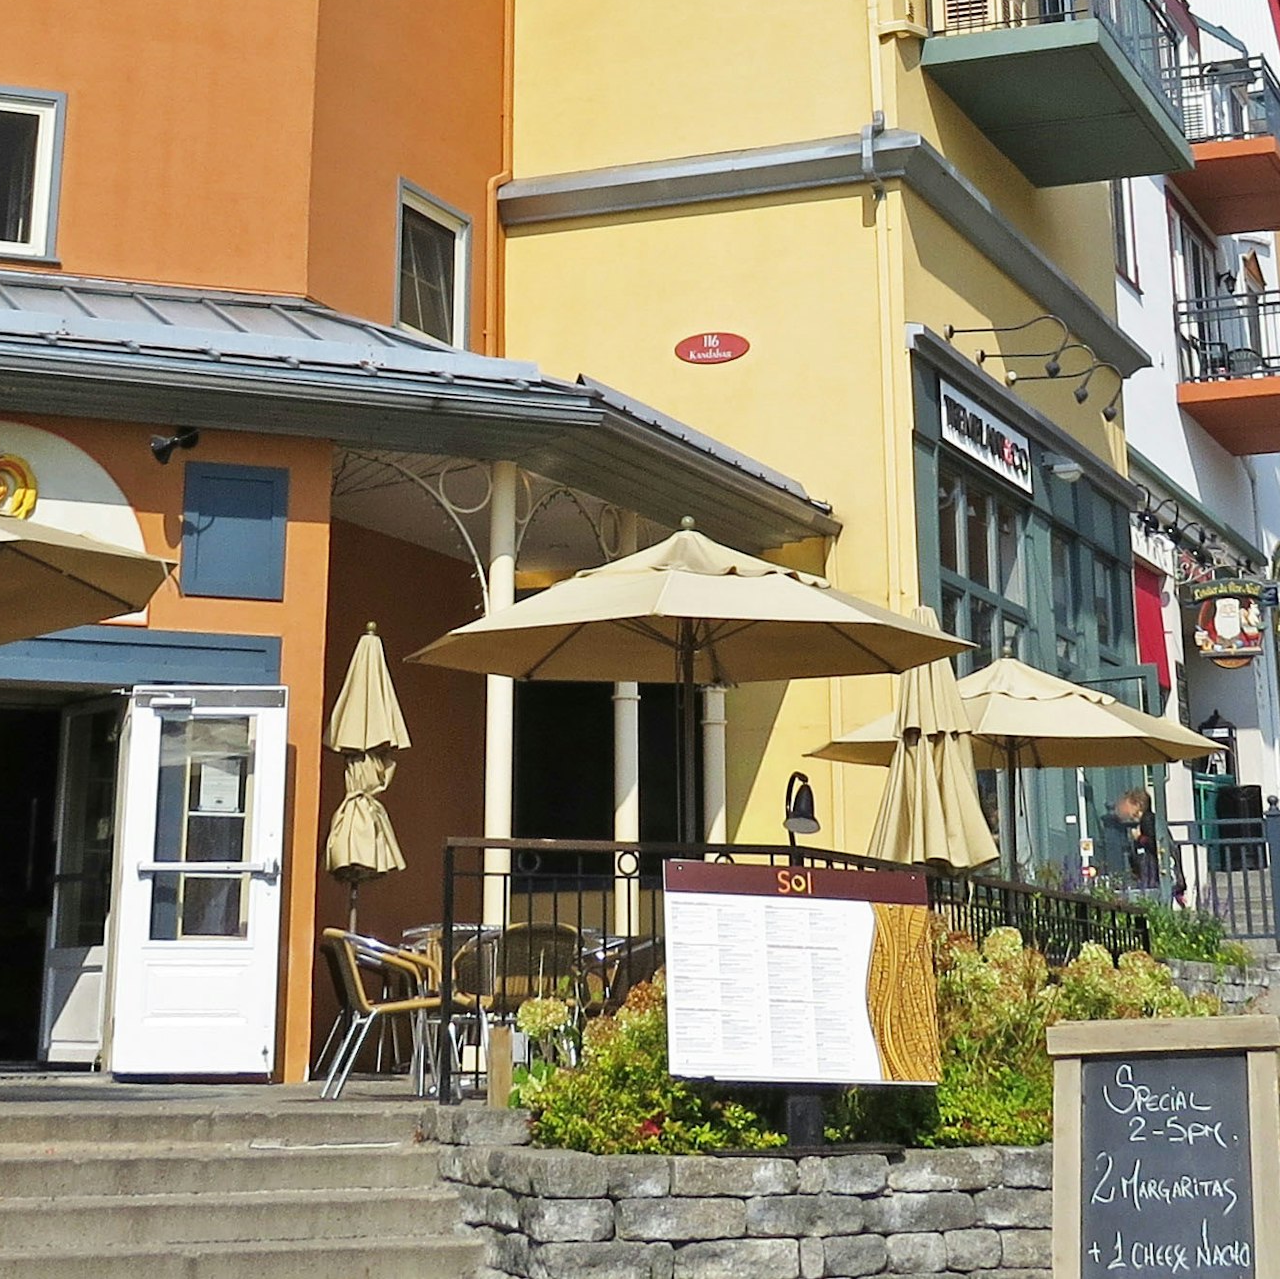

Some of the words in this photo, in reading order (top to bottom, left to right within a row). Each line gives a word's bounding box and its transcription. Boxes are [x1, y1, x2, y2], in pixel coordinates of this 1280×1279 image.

[703, 334, 720, 348] 116
[689, 348, 733, 360] Kandahar
[777, 870, 812, 894] Sol
[1090, 1151, 1115, 1204] 2
